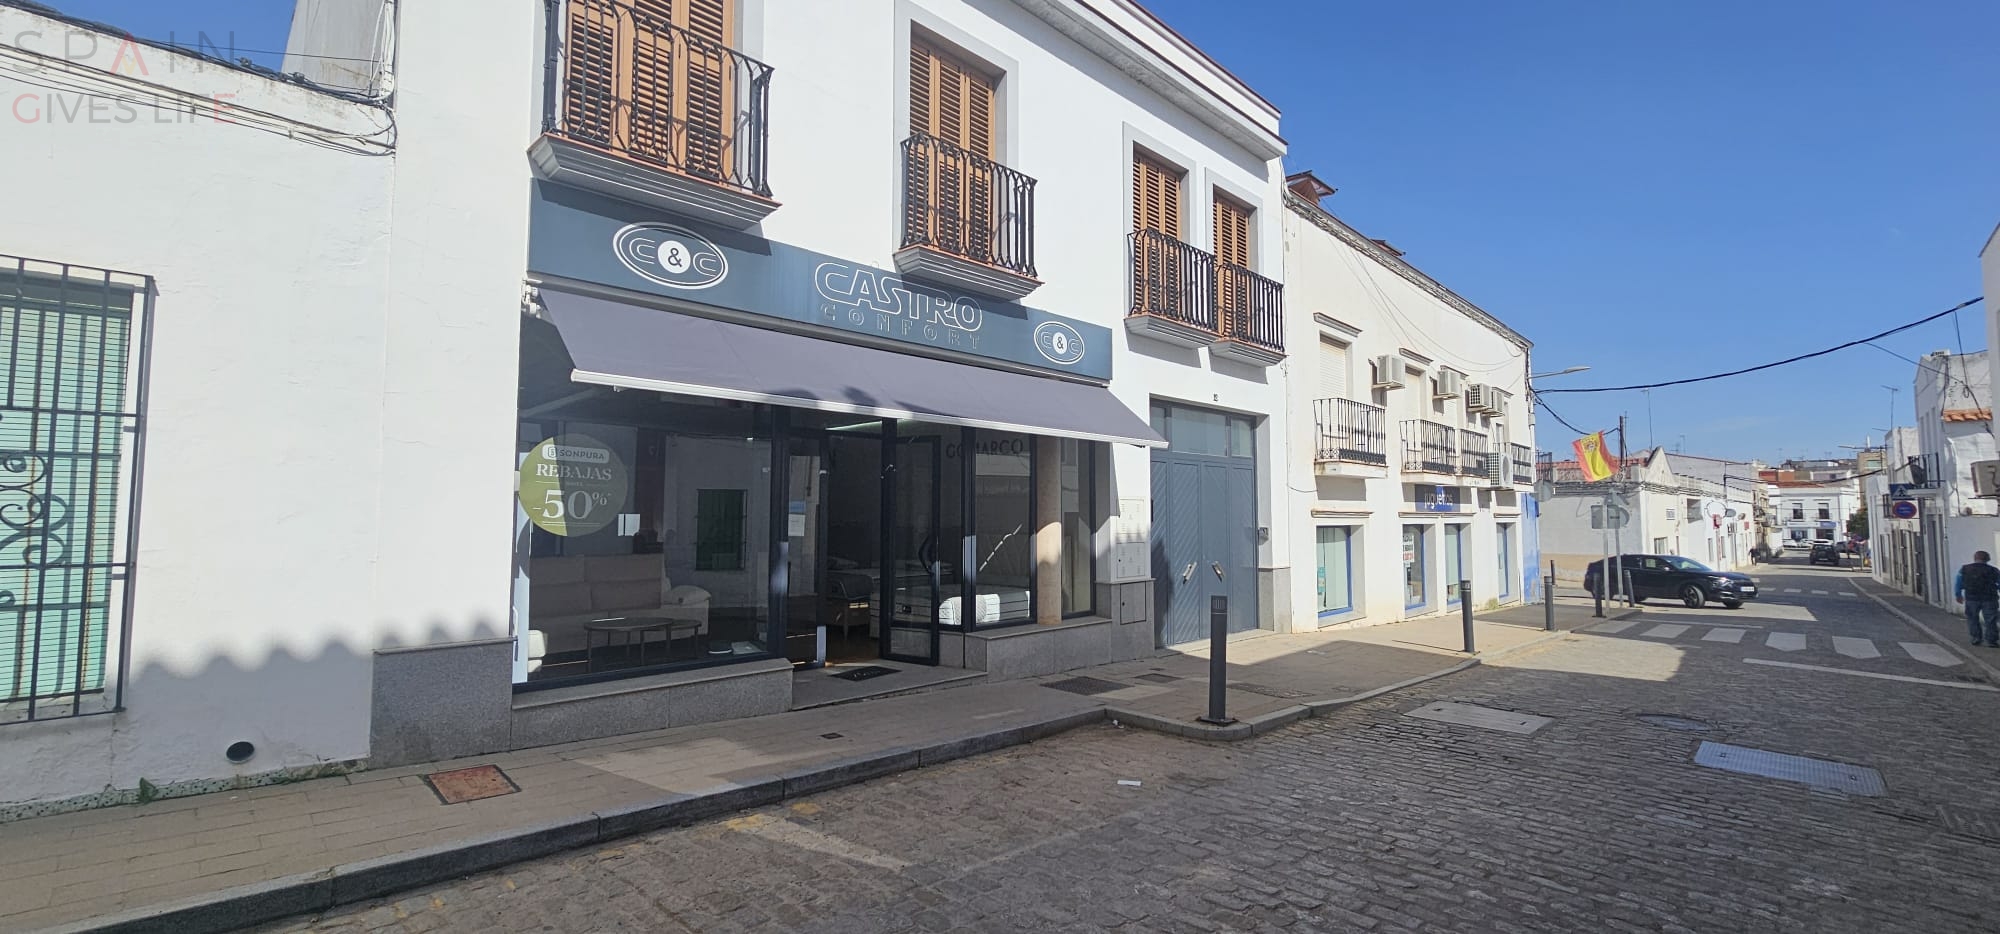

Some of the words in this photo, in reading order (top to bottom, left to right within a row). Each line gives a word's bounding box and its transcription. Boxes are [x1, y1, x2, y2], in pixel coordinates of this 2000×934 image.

[815, 262, 983, 332] CASTRO
[820, 303, 980, 349] CONFORT
[560, 449, 605, 460] SONPURA
[535, 463, 612, 480] REBAJAS
